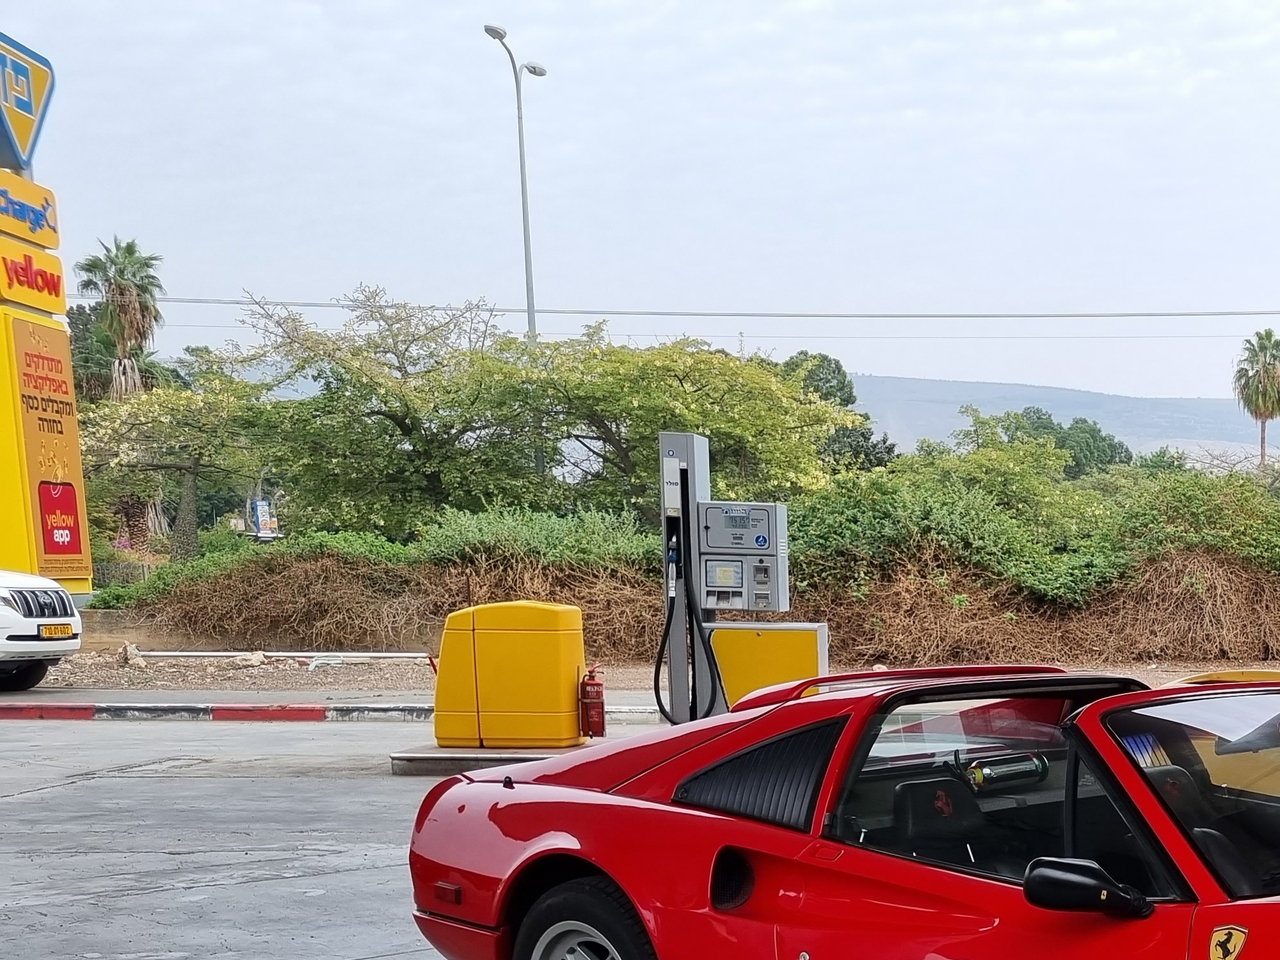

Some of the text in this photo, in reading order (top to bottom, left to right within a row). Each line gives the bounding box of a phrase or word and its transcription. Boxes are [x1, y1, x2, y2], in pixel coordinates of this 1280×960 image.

[2, 254, 60, 297] yellow
[24, 351, 63, 375] מתדלקים
[23, 372, 69, 396] באפליקציה
[21, 393, 74, 419] ומקבלים כסף
[46, 510, 74, 530] yellow
[53, 529, 70, 545] app
